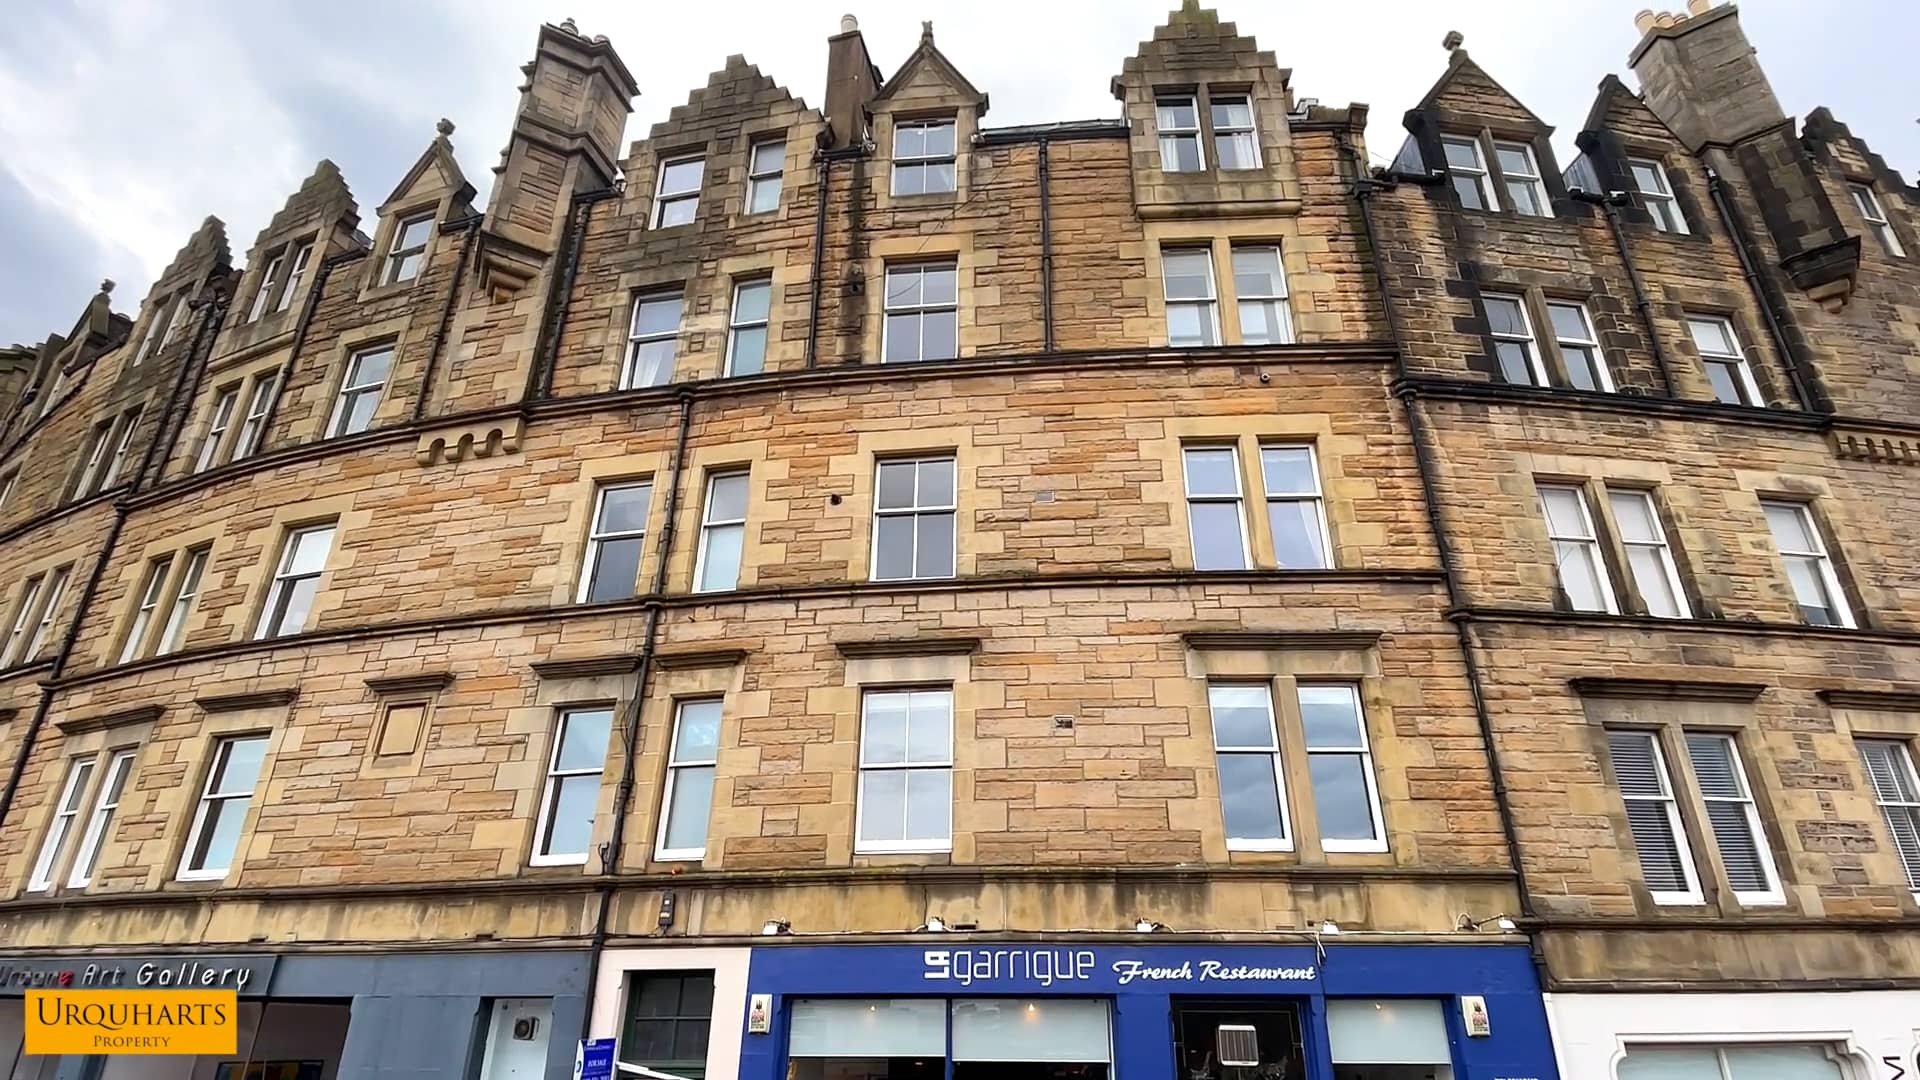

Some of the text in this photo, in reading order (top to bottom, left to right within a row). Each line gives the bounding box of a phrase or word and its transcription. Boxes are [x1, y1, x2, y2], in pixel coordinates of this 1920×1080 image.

[81, 963, 122, 986] Art
[136, 962, 251, 992] Gallery
[953, 951, 1095, 986] garrigue
[1112, 961, 1316, 985] French Restaurant
